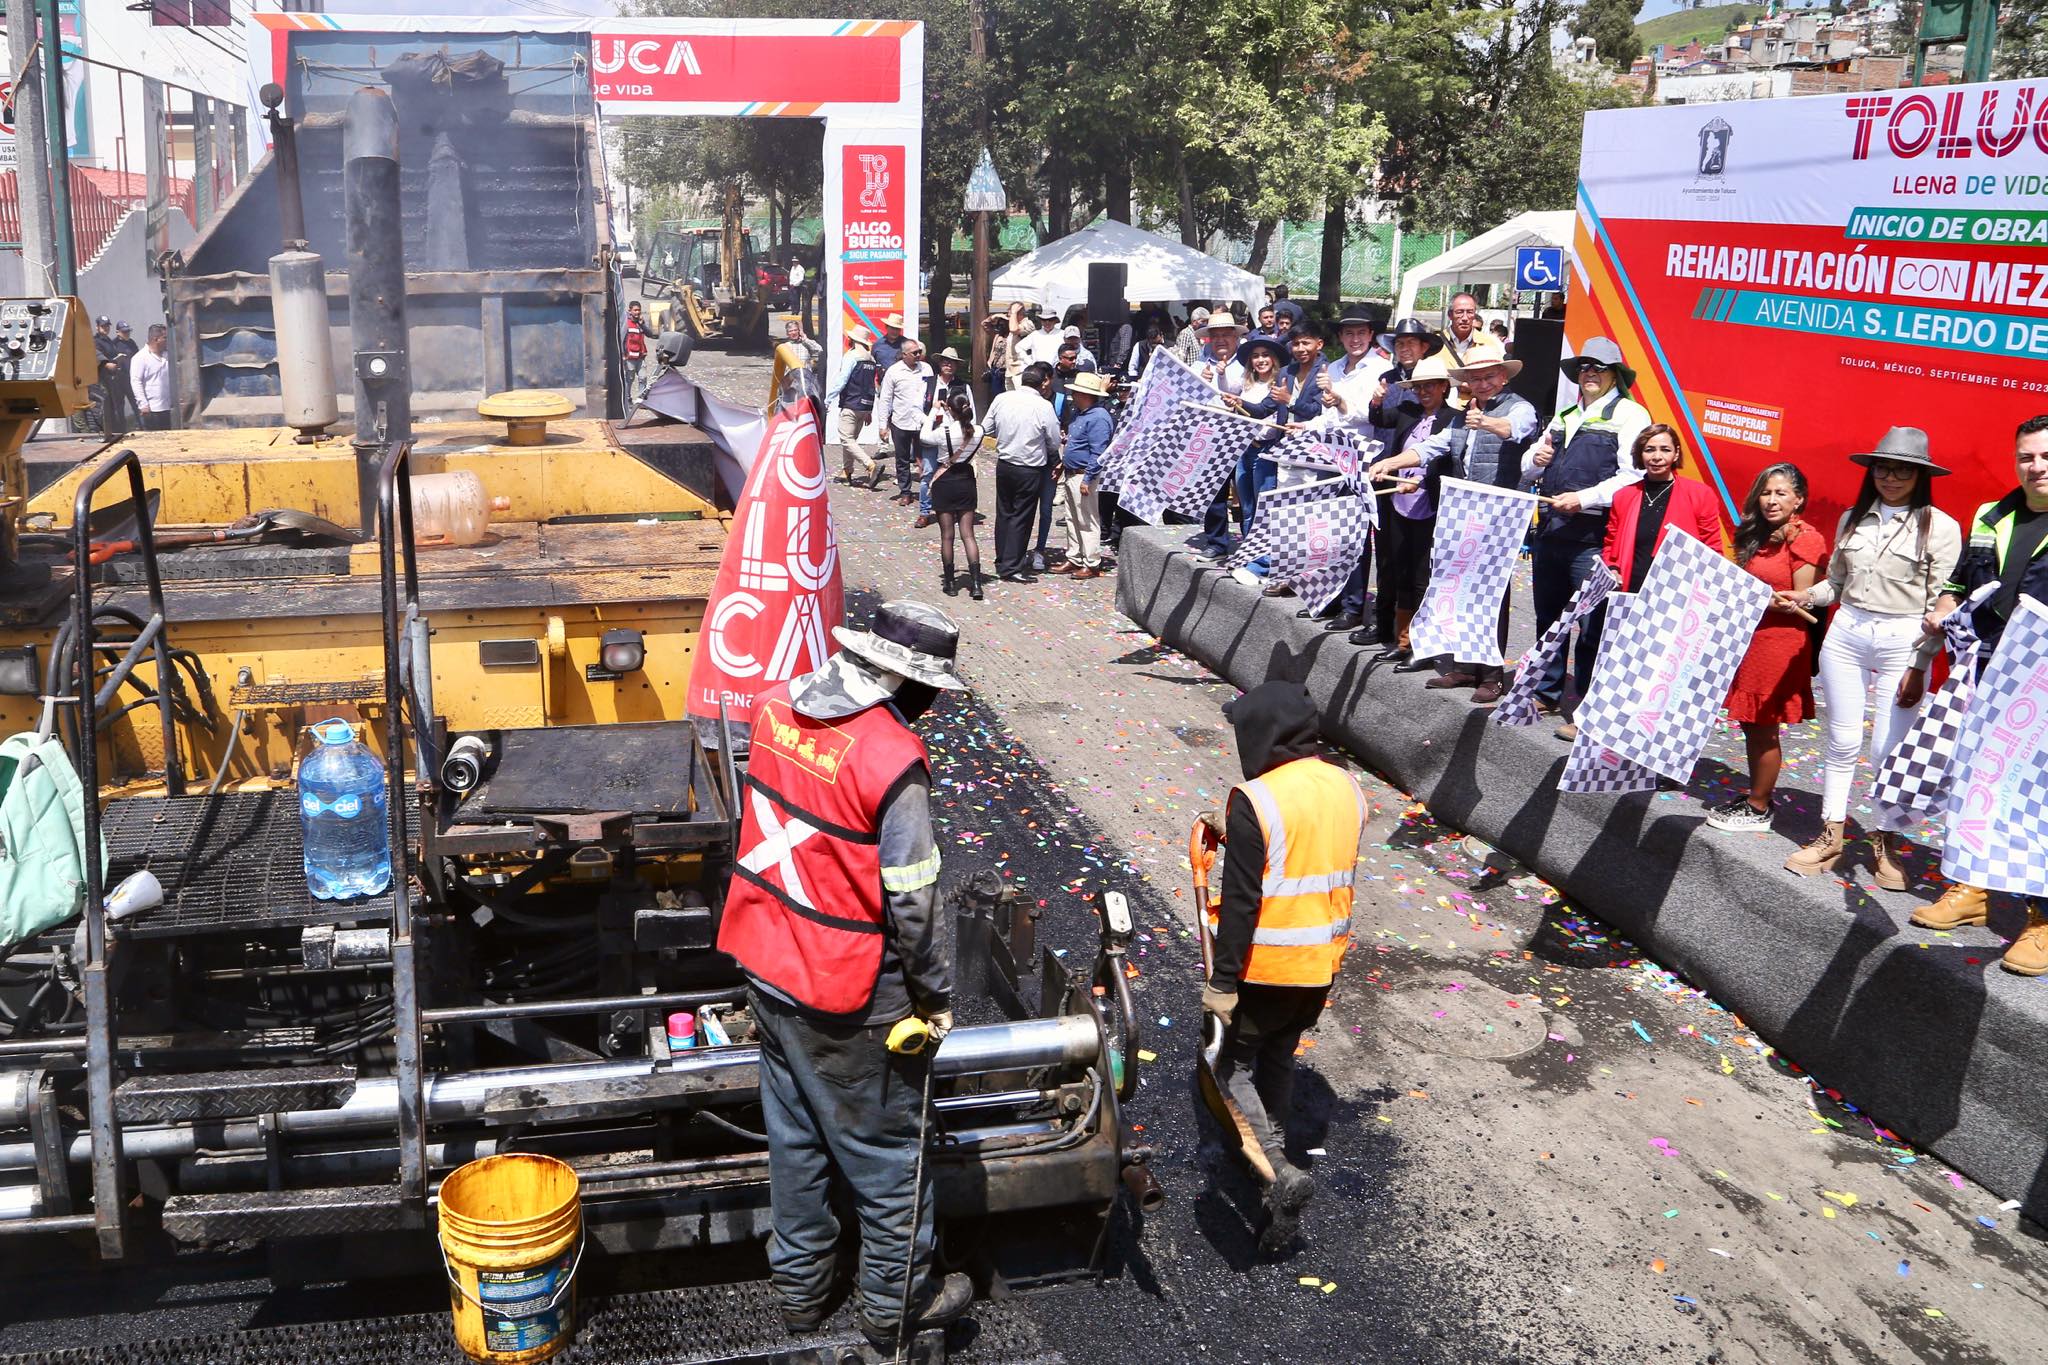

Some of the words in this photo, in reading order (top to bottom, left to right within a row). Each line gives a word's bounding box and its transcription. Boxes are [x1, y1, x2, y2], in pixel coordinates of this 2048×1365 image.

[845, 221, 892, 238] ¡ALGO
[1850, 214, 1925, 238] INICIO
[1928, 216, 1968, 240] DE
[1970, 217, 2048, 243] OBRA
[848, 235, 903, 249] BUENO
[1665, 243, 1890, 295] REHABILITACIÓN
[1898, 262, 1964, 296] CON
[1755, 297, 1857, 333] AVENIDA
[1863, 307, 1888, 336] S.
[1894, 312, 1998, 348] LERDO
[2005, 321, 2048, 354] DE
[1840, 356, 1881, 371] TOLUCA,
[1883, 361, 1926, 377] MÉXICO,
[1930, 369, 1998, 386] SEPTIEMBRE
[2002, 378, 2018, 389] DE
[1704, 409, 1720, 422] POR
[1721, 413, 1767, 431] RECUPERAR
[1703, 422, 1742, 440] NUESTRAS
[1743, 430, 1772, 446] CALLES
[334, 799, 359, 813] ciel
